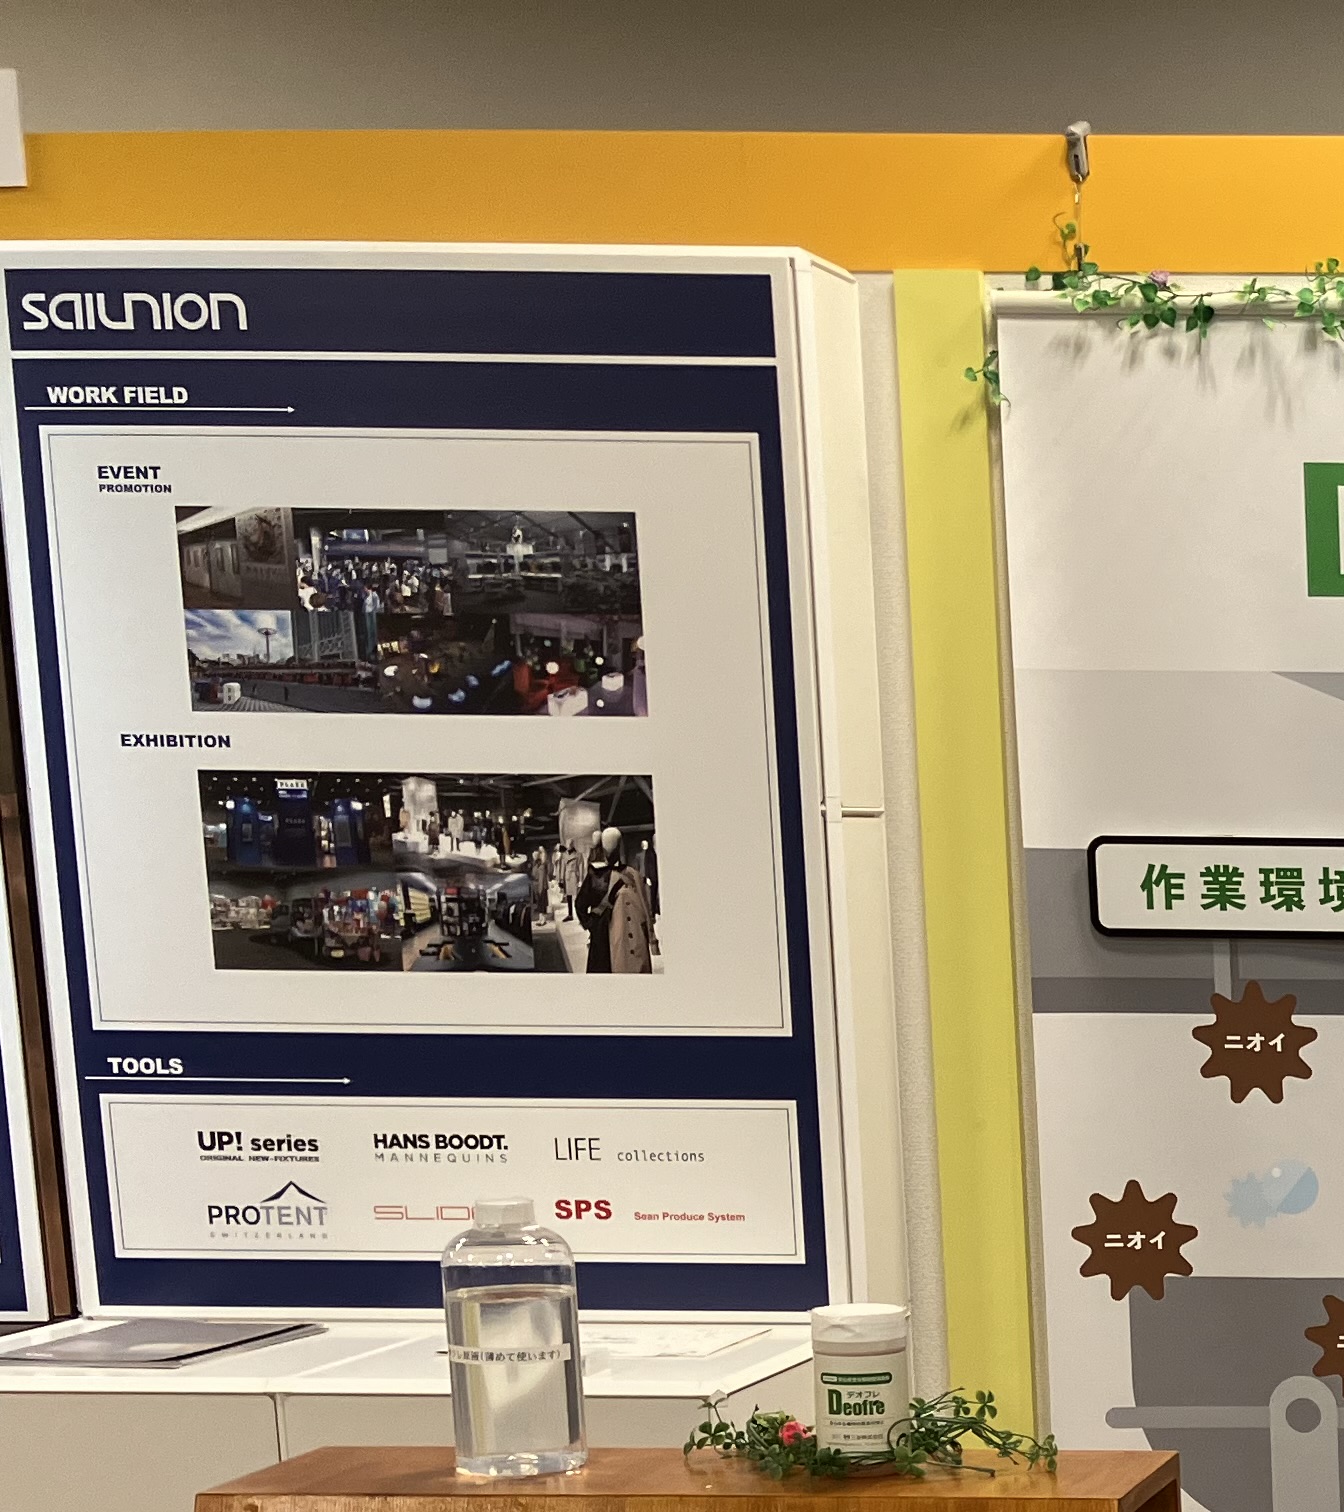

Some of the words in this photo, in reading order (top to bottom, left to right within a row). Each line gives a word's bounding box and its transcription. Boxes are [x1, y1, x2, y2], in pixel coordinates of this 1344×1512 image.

[46, 385, 118, 405] WORK
[123, 385, 190, 405] FIELD
[96, 464, 162, 480] EVENT
[97, 482, 173, 494] PROMOTION
[119, 732, 232, 749] EXHIBITION
[1223, 1032, 1287, 1052] ニオイ
[107, 1057, 184, 1075] TOOLS
[196, 1130, 243, 1152] UP!
[249, 1133, 320, 1153] series
[373, 1133, 431, 1150] HANS
[434, 1134, 509, 1151] BOODT.
[553, 1136, 602, 1162] LIFE
[616, 1149, 706, 1164] collections
[373, 1152, 508, 1164] MANNEQUINS
[207, 1204, 328, 1226] PROTENT
[373, 1205, 476, 1221] SLID
[554, 1199, 613, 1221] SPS
[661, 1211, 705, 1222] Produce
[706, 1211, 746, 1224] System
[1103, 1231, 1168, 1251] ニオイ
[827, 1388, 886, 1416] Deofre
